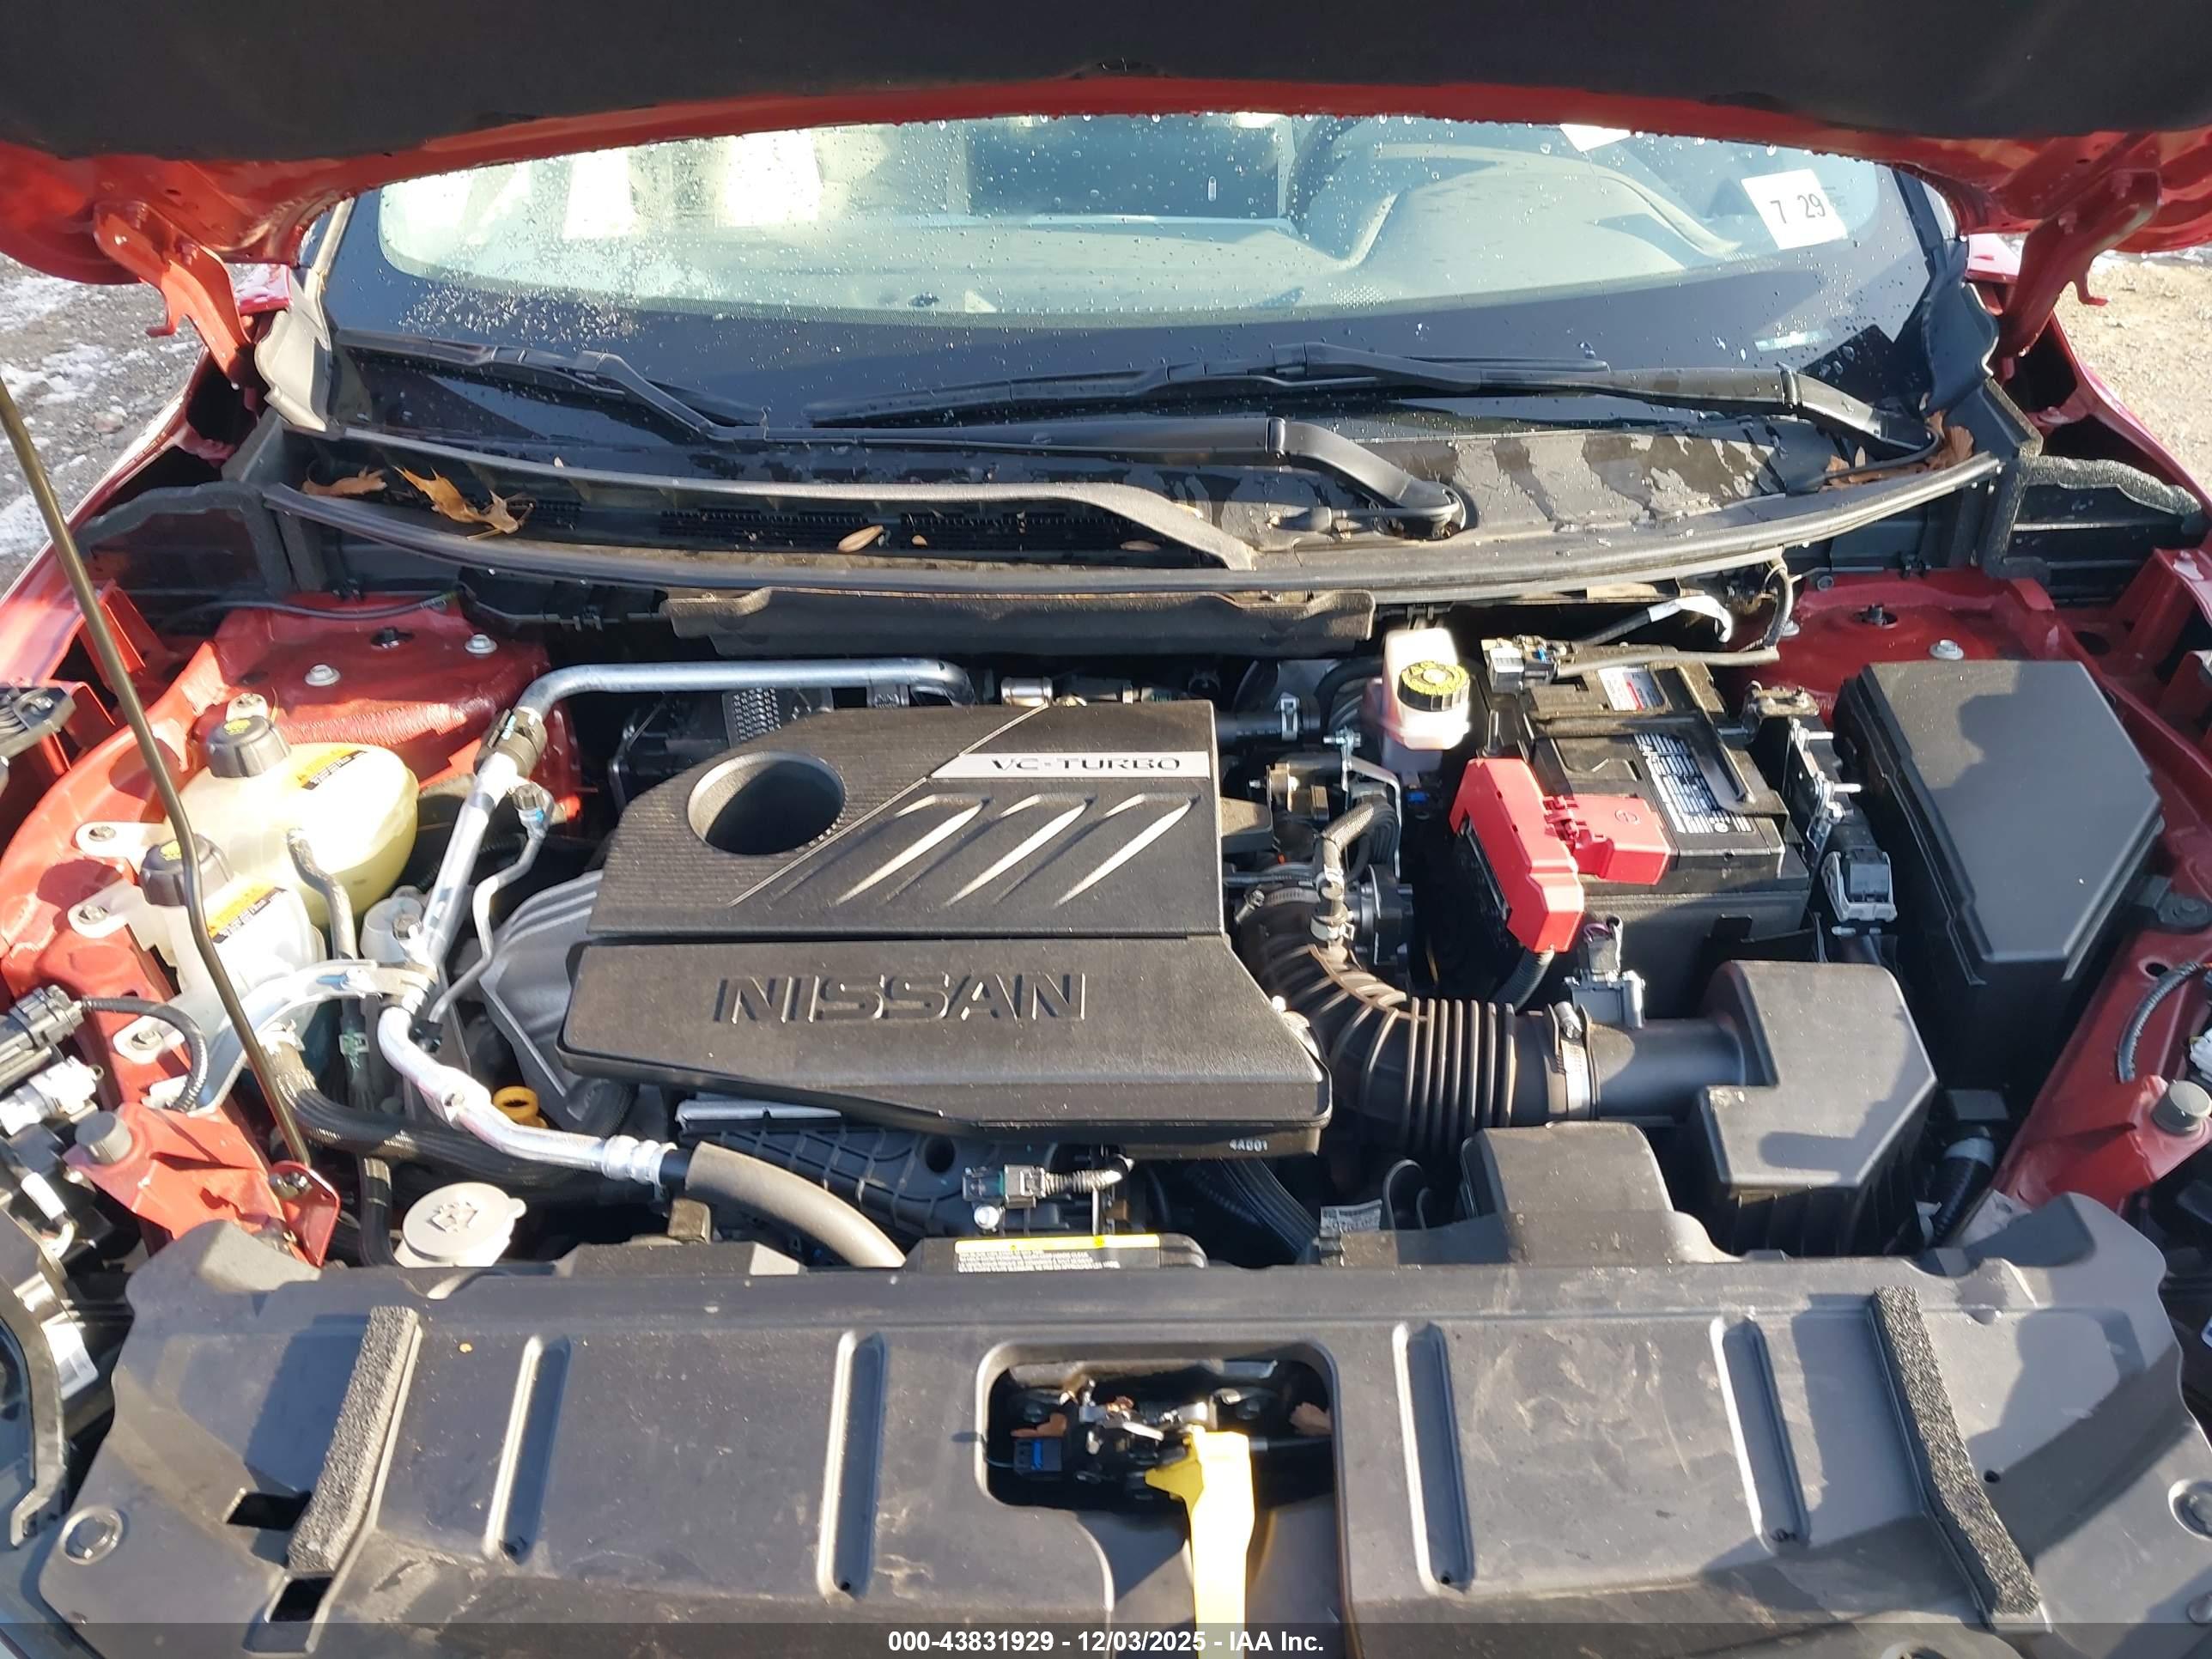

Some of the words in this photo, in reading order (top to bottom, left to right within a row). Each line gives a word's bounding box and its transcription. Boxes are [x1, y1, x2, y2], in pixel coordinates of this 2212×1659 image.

[1770, 199, 1787, 223] 7
[1796, 193, 1826, 218] 29
[991, 757, 1181, 771] VC-TURBO
[713, 973, 1086, 1024] NISSAN
